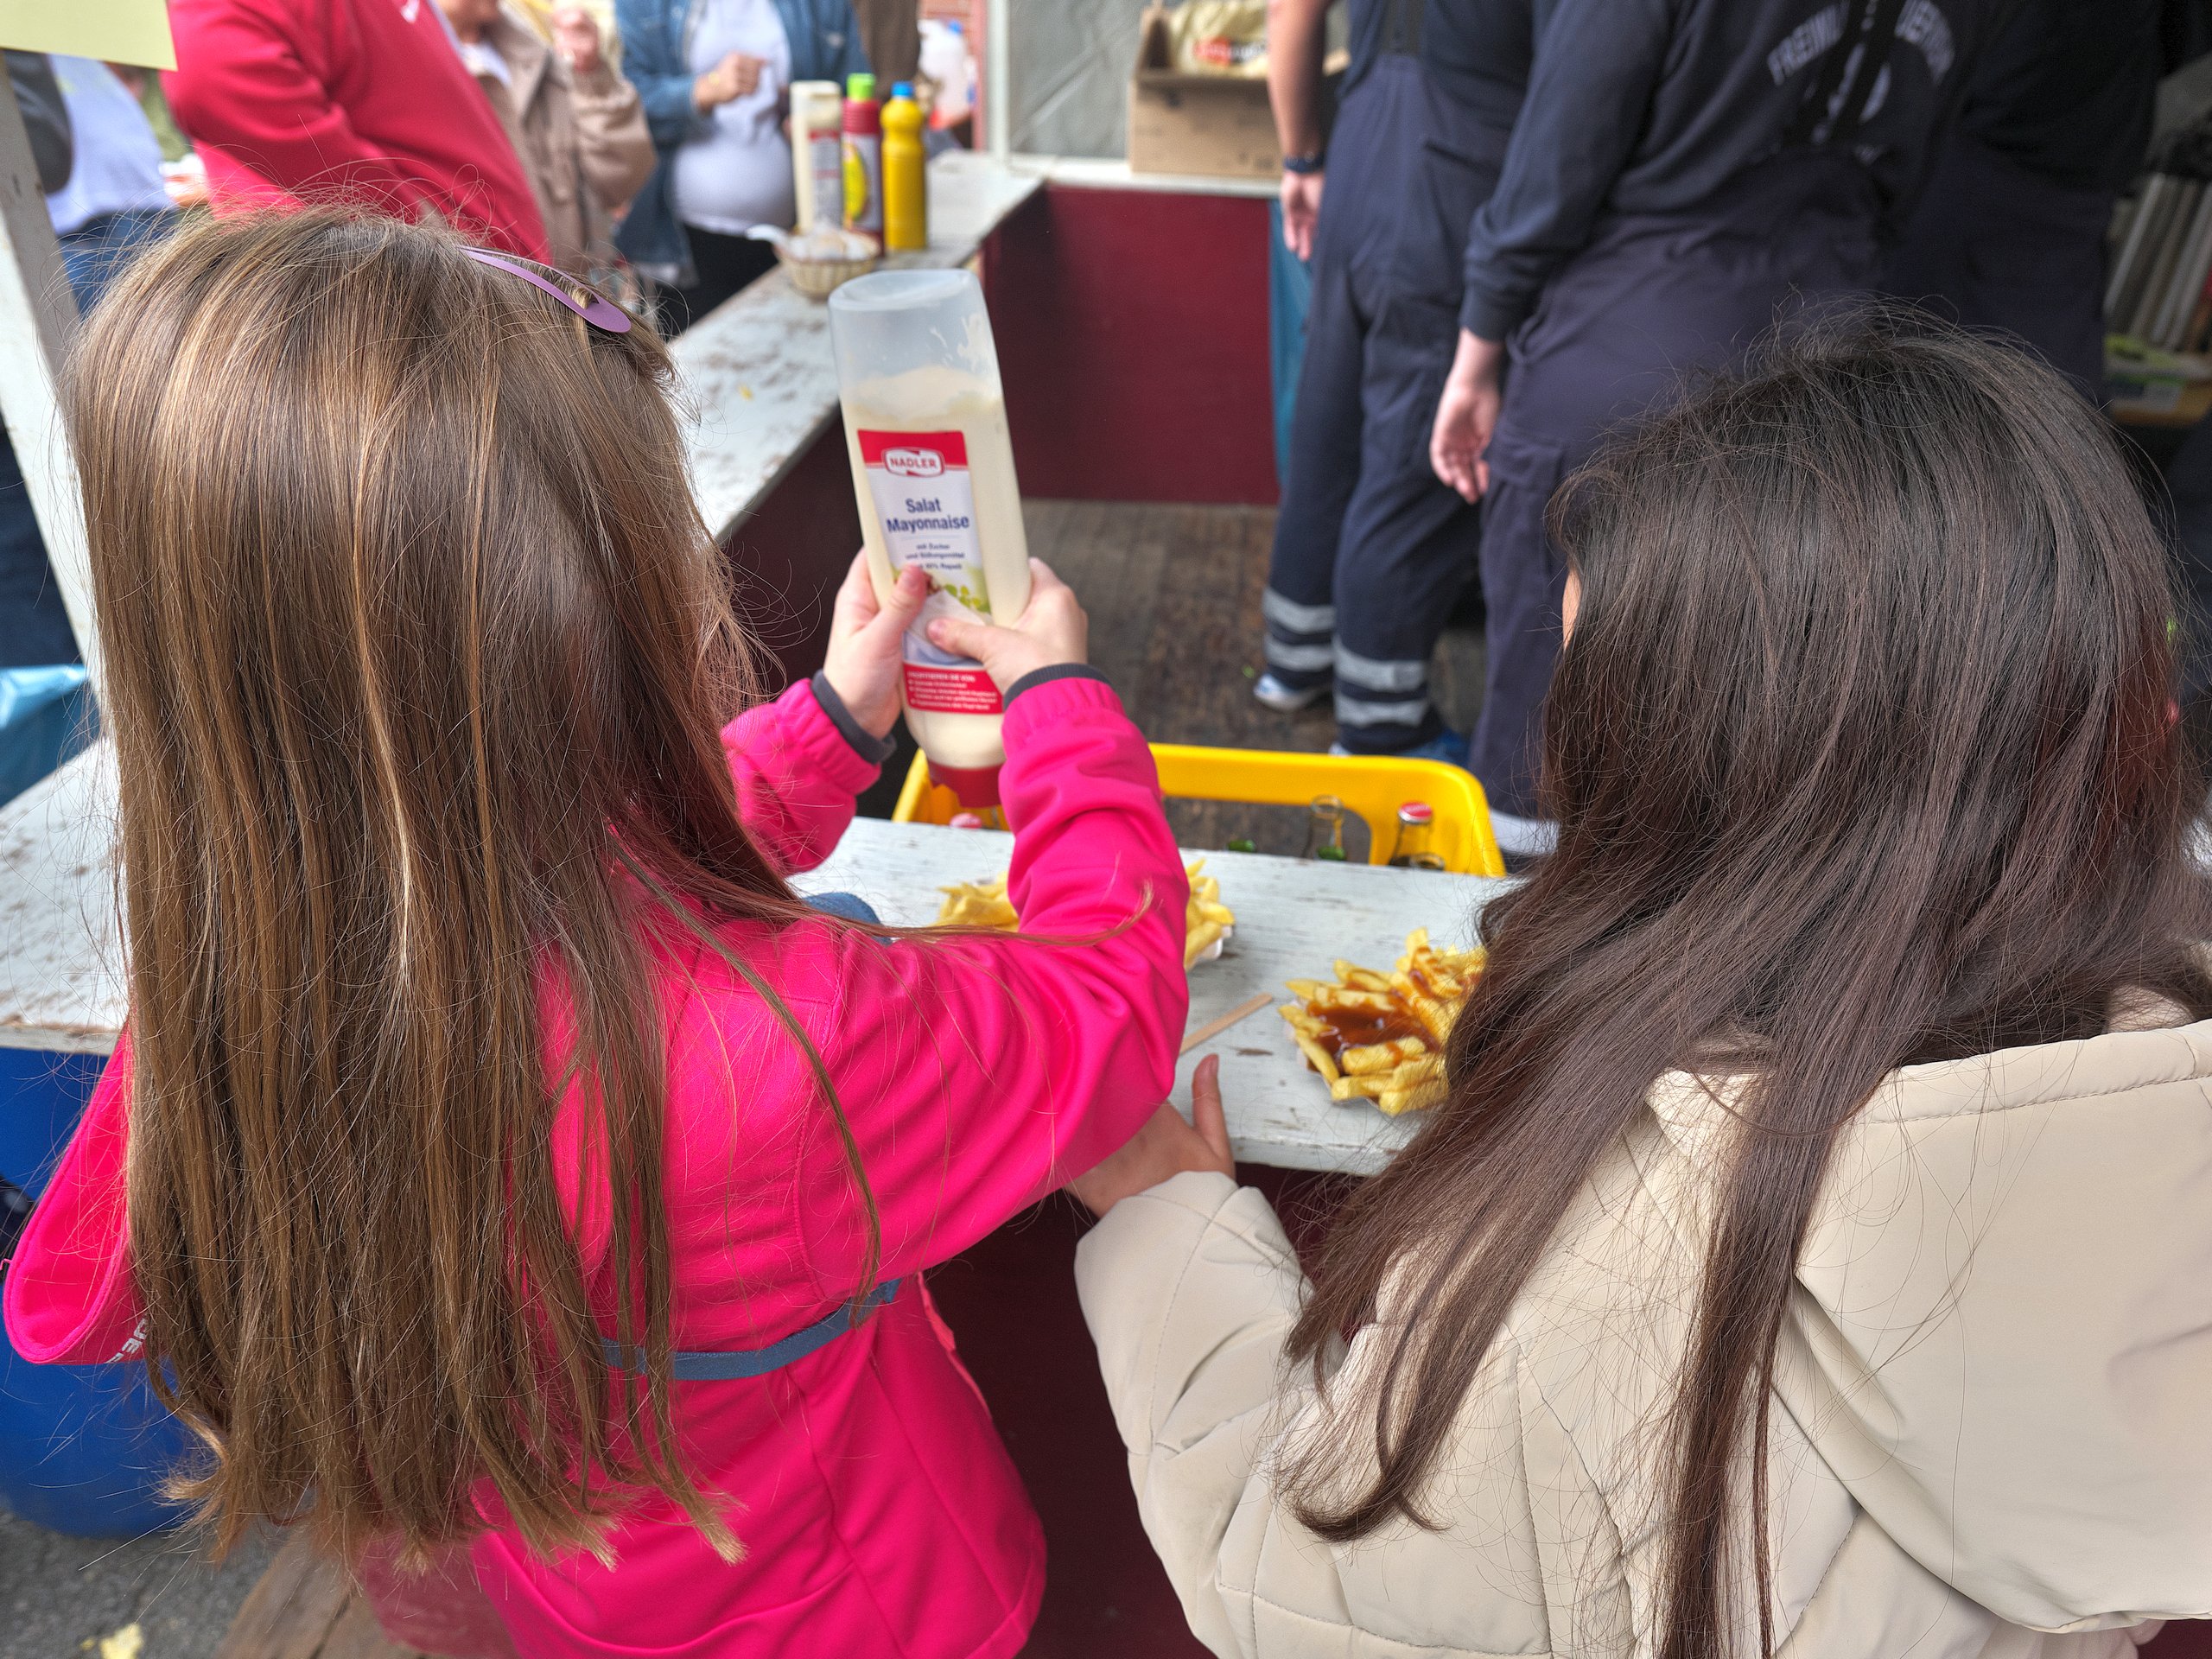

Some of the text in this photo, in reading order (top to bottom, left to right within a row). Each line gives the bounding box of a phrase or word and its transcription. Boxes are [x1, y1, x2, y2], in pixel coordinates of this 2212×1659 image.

[890, 457, 937, 469] NADLER
[905, 497, 942, 513] Salat
[886, 515, 969, 534] Mayonnaise
